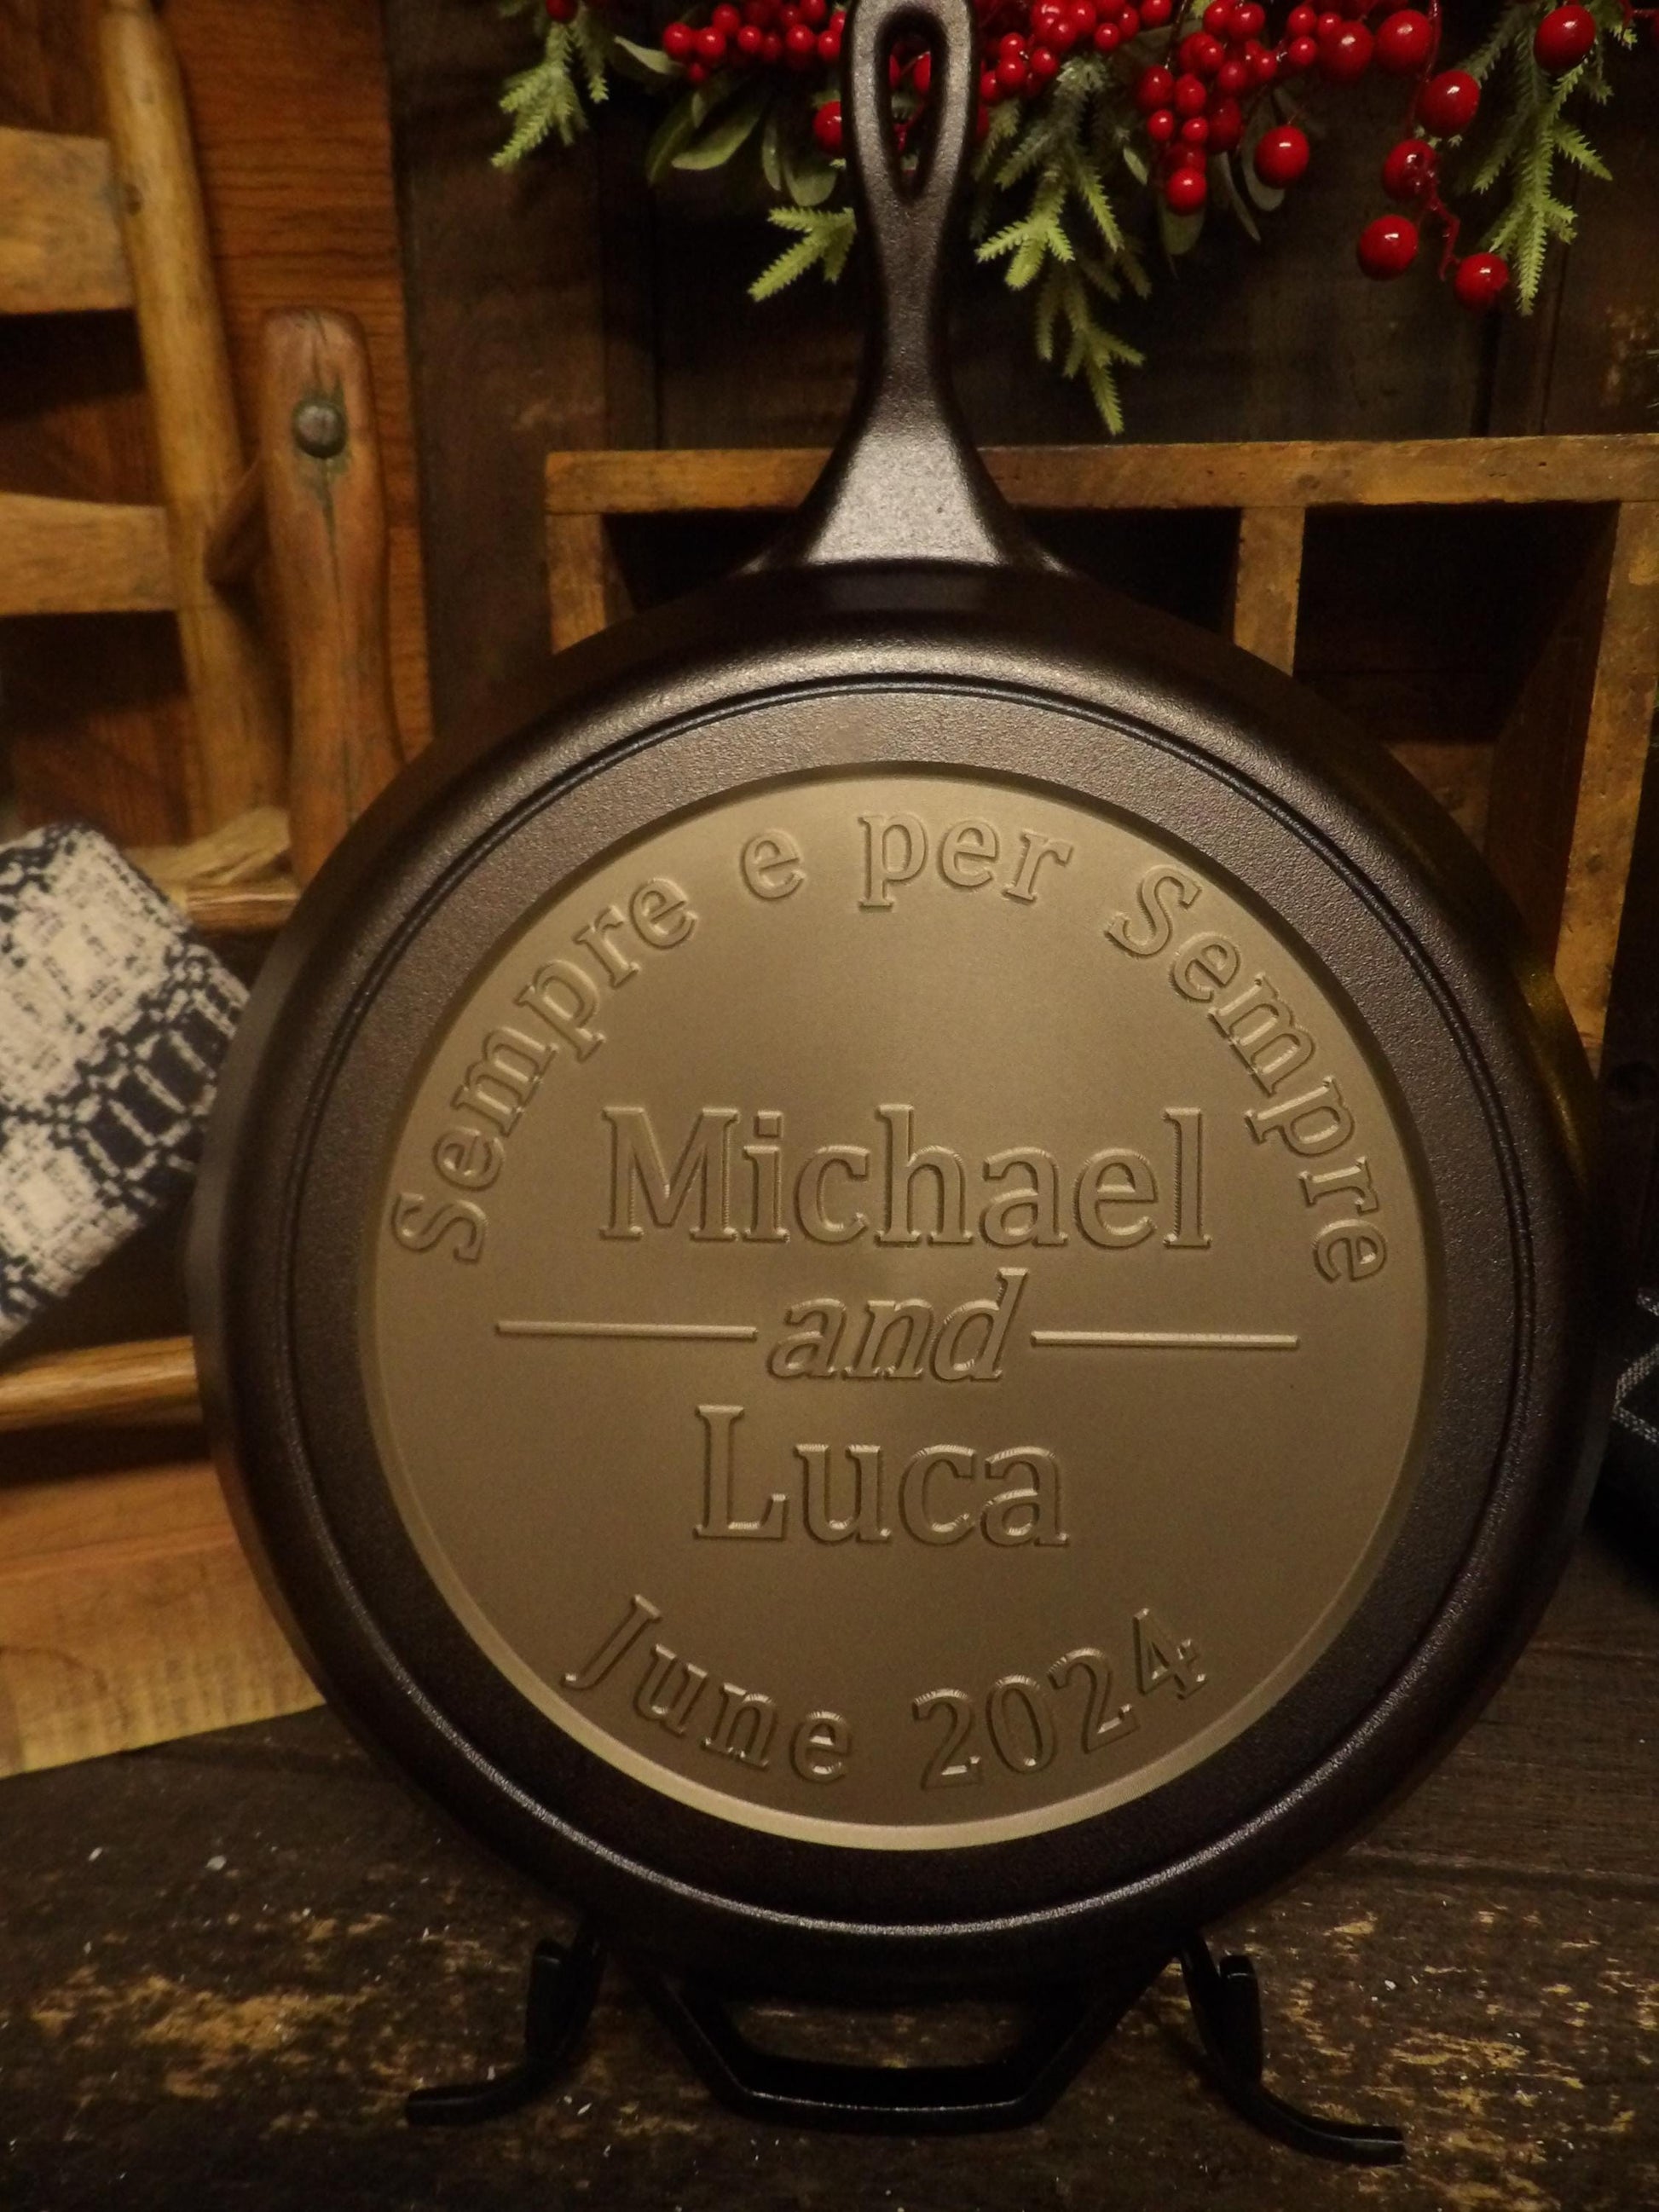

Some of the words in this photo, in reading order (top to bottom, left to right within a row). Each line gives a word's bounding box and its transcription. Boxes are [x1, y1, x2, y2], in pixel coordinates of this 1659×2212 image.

[390, 875, 698, 1265] Sempre
[739, 828, 806, 901] e
[858, 812, 1073, 910] per
[1105, 863, 1388, 1283] Sempre
[599, 1103, 1212, 1249] Michael
[766, 1266, 1028, 1381] and
[692, 1404, 1070, 1548] Luca
[561, 1592, 852, 1783] June
[911, 1607, 1207, 1791] 2024
